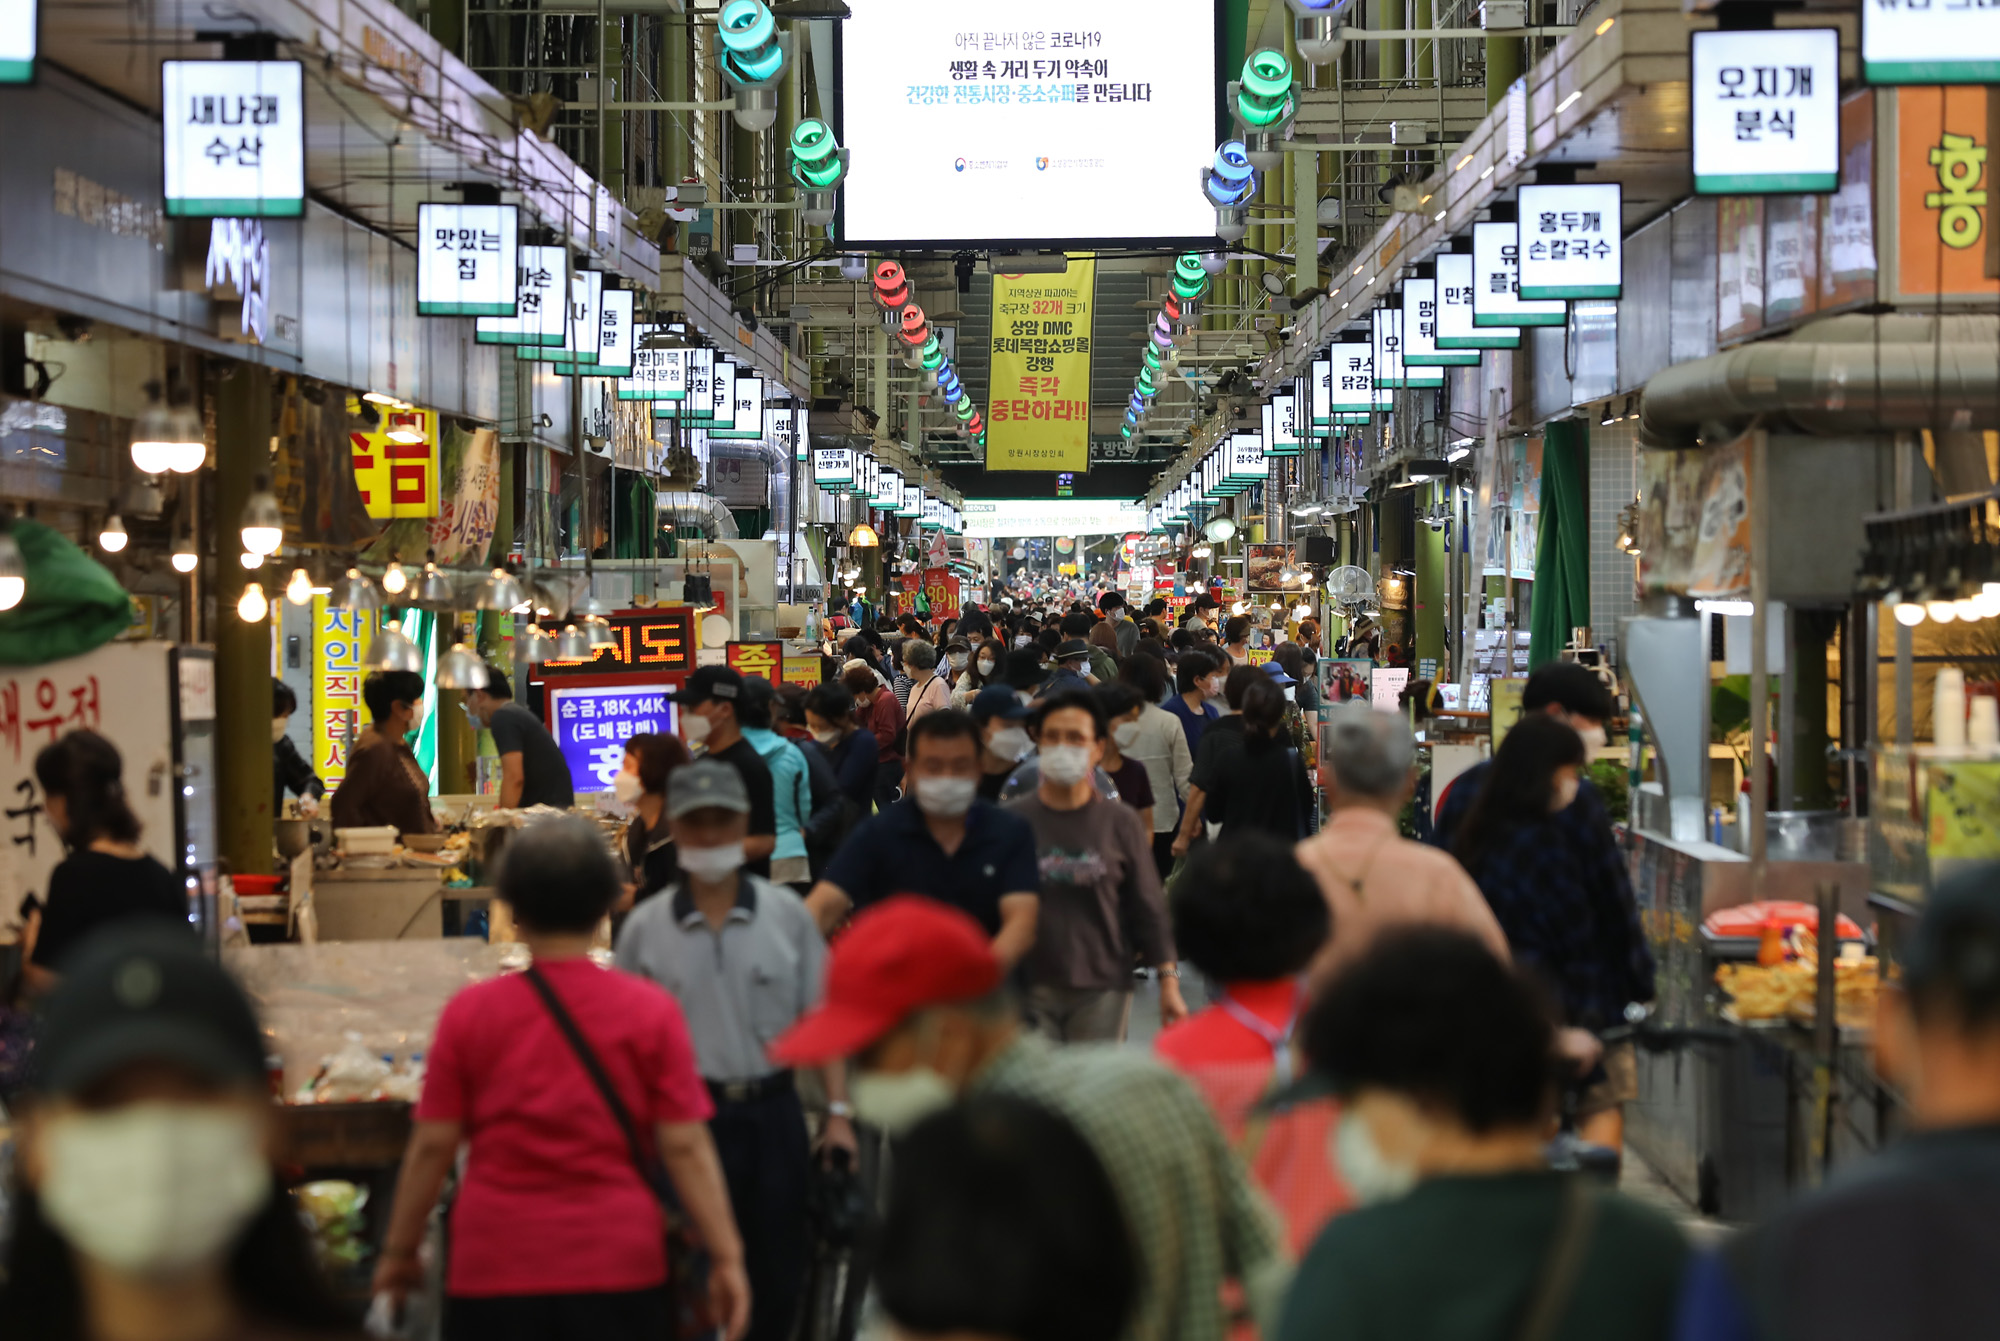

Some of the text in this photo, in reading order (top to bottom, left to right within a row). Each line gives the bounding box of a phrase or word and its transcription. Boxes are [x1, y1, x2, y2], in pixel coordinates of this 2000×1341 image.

[955, 31, 1101, 50] 아직 끝나지 않은 코로나19
[949, 59, 1108, 80] 생활 속 거리 두기 약속이
[1717, 65, 1813, 99] 오지개
[906, 83, 1152, 105] 건강한 전통시장·중소슈퍼를 만듭니다
[188, 95, 278, 126] 새나래
[1735, 109, 1795, 141] 분식
[205, 136, 263, 166] 수산
[1926, 130, 1987, 249] 홍
[1539, 212, 1601, 233] 홍두깨
[436, 229, 500, 251] 맛있는
[1528, 239, 1612, 260] 손칼국수
[458, 258, 476, 280] 집
[520, 293, 541, 313] 찬
[1008, 289, 1078, 298] 지역상권 파괴하는
[999, 300, 1086, 315] 축구장 32개 크기
[1010, 321, 1073, 335] 상암 DMC
[993, 337, 1089, 354] 롯데복합쇼핑몰
[634, 353, 679, 367] 원어묵
[1025, 357, 1054, 372] 강행
[624, 369, 680, 381] 식전문점
[1342, 375, 1373, 390] 닭강
[1019, 376, 1060, 397] 즉각
[735, 399, 752, 411] 락
[991, 399, 1087, 422] 중단하라!!
[818, 460, 850, 469] 신발가게
[821, 450, 845, 459] 모든발
[927, 585, 947, 603] 80
[731, 644, 777, 680] 족
[561, 697, 667, 719] 순금,18K,14K
[571, 718, 659, 742] (도매판매)
